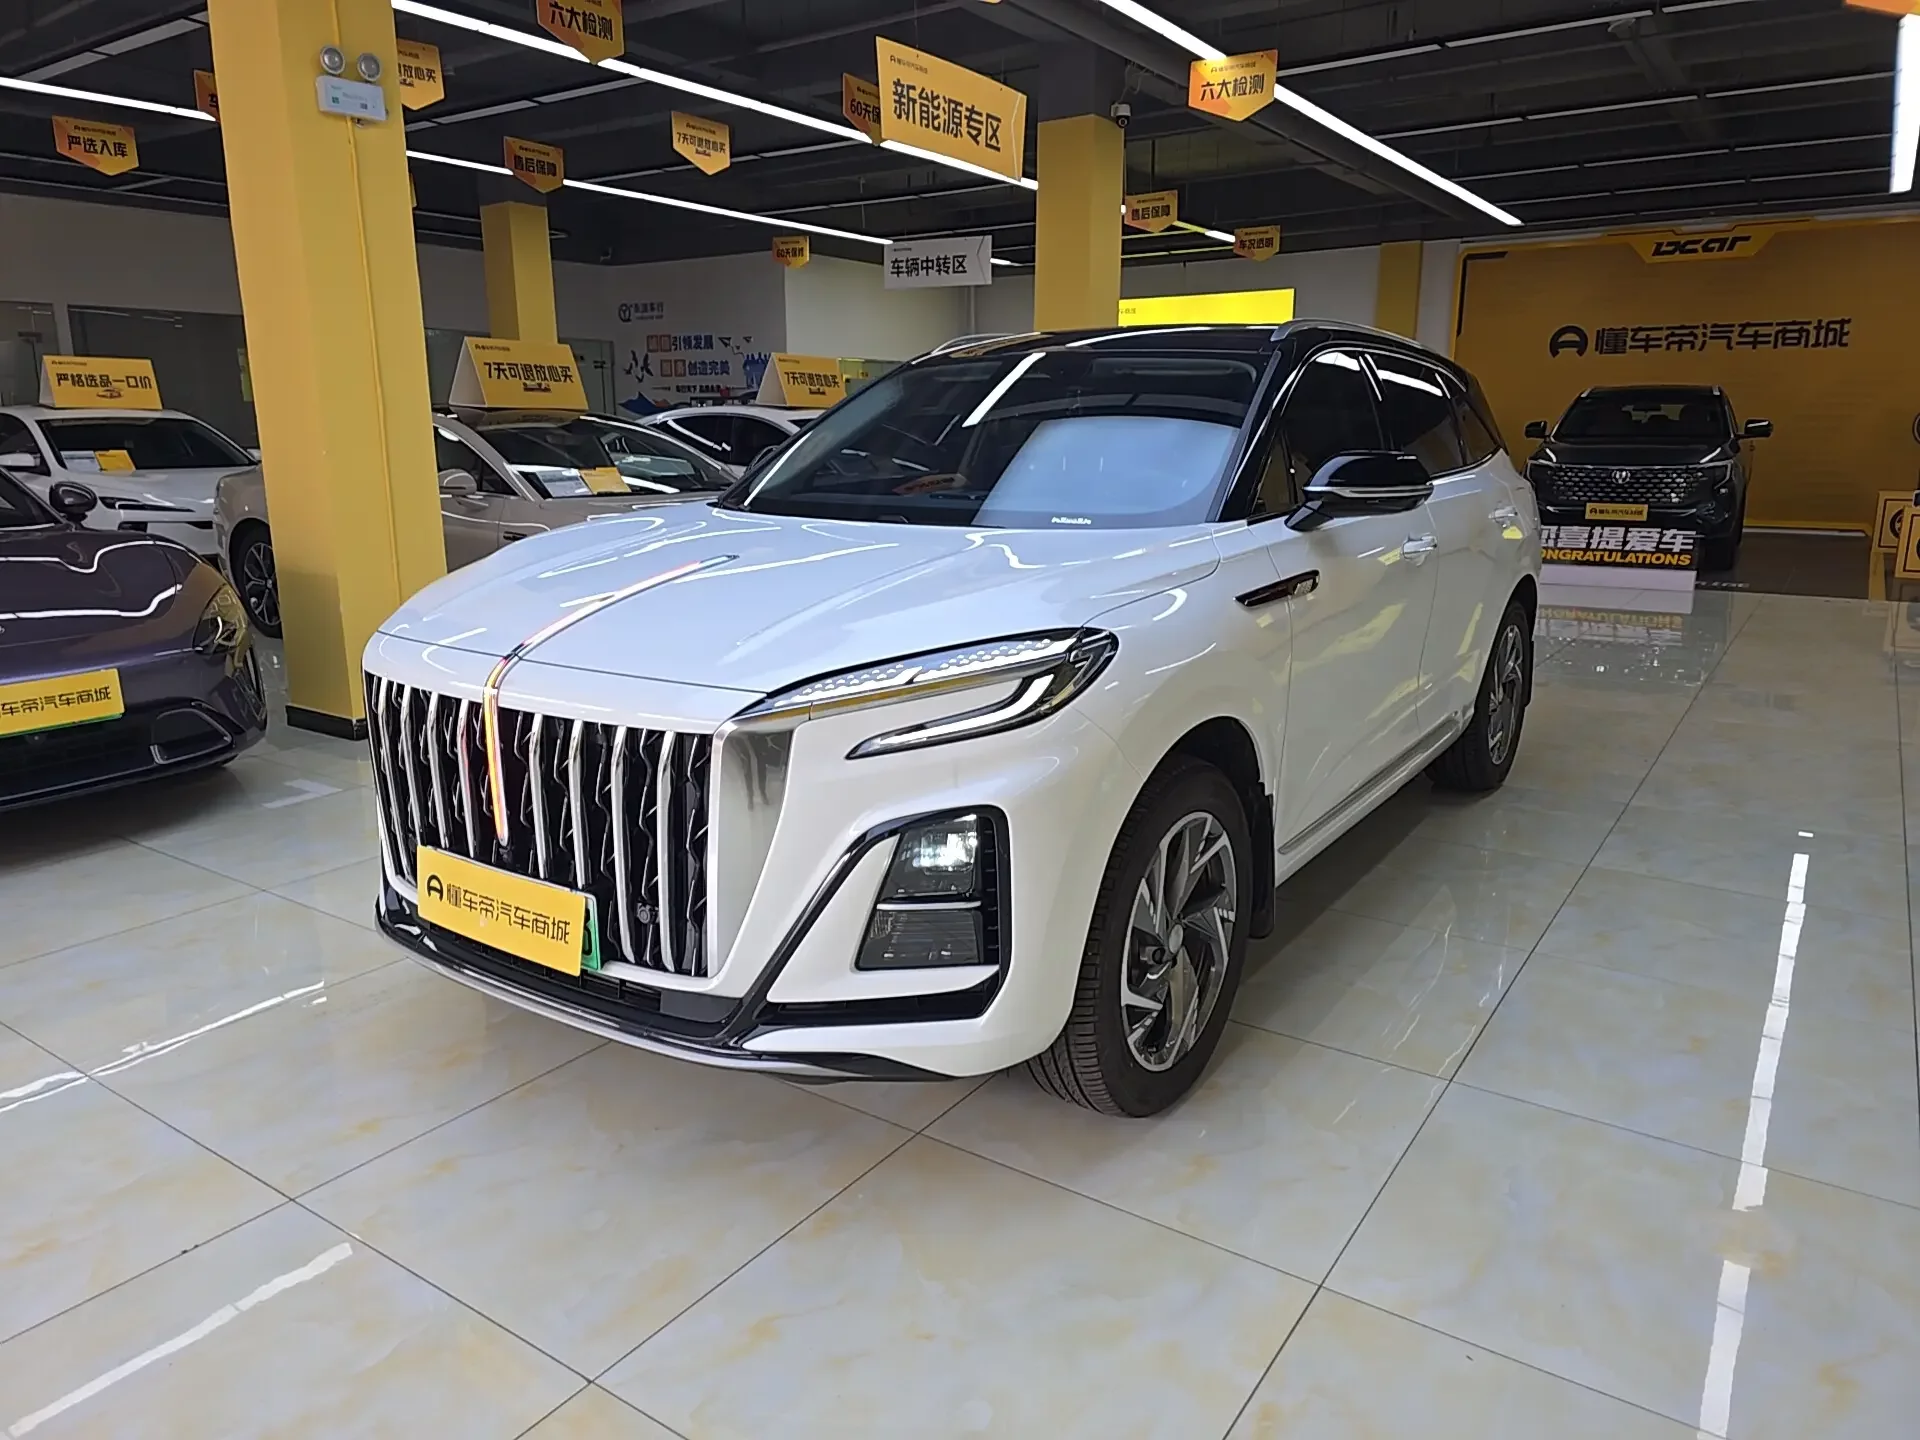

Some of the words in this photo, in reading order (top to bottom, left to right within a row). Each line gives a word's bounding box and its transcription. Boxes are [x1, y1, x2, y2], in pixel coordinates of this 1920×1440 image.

[549, 1, 613, 41] 六大检测
[398, 63, 436, 83] 放心买
[1201, 73, 1265, 101] 六大检测
[892, 78, 1002, 152] 新能源专区
[67, 135, 128, 158] 严选入库
[890, 254, 967, 278] 车辆中转区
[1594, 317, 1852, 355] 懂车帝汽车商城
[56, 372, 152, 389] 严格选品一口价
[484, 361, 574, 383] 7天可退放心买
[0, 686, 112, 718] 车帝汽车商城
[447, 883, 571, 944] 懂车帝汽车商城
